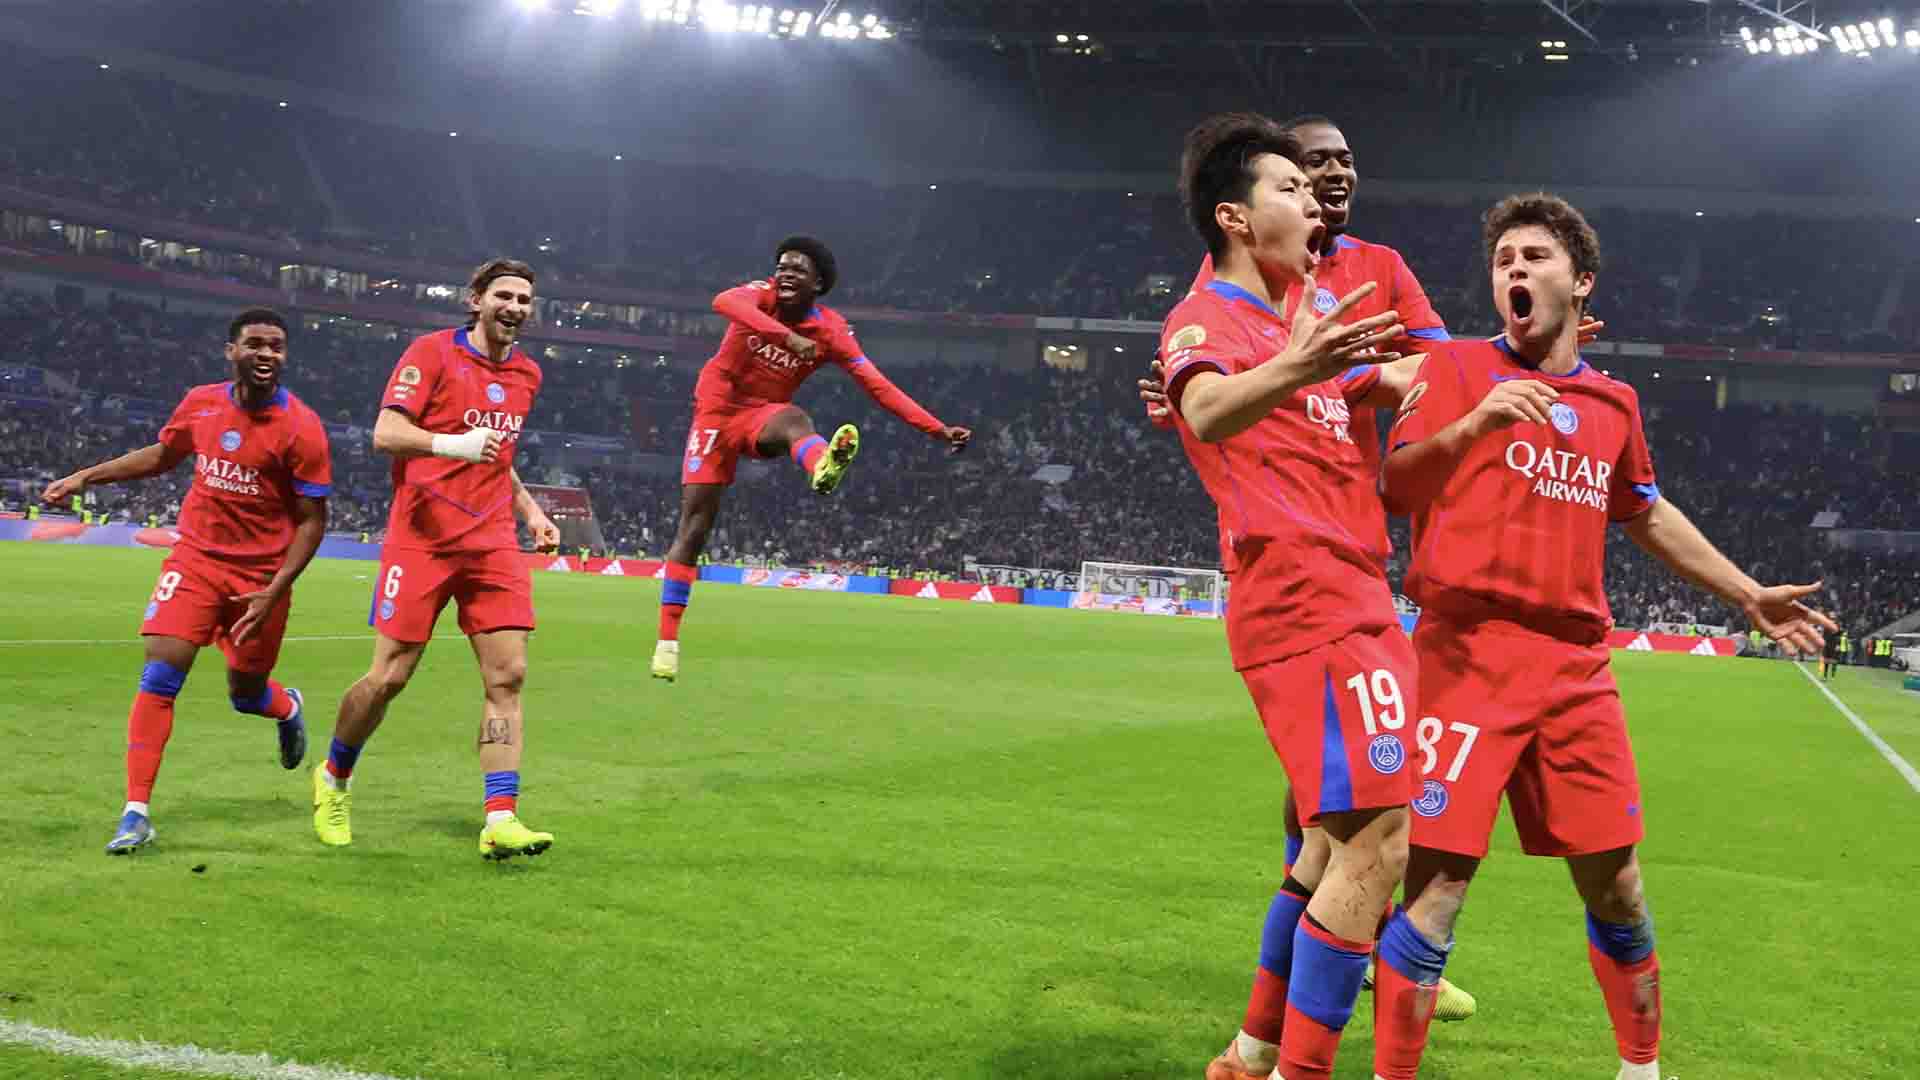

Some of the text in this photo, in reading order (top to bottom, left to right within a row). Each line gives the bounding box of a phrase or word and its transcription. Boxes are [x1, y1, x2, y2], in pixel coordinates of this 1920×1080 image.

[463, 408, 523, 433] QATAR
[688, 429, 721, 456] 47
[1505, 440, 1611, 493] QATAR
[1532, 476, 1608, 512] AIRWAYS
[384, 564, 403, 599] 6
[1346, 668, 1406, 736] 19
[1415, 716, 1481, 782] 87
